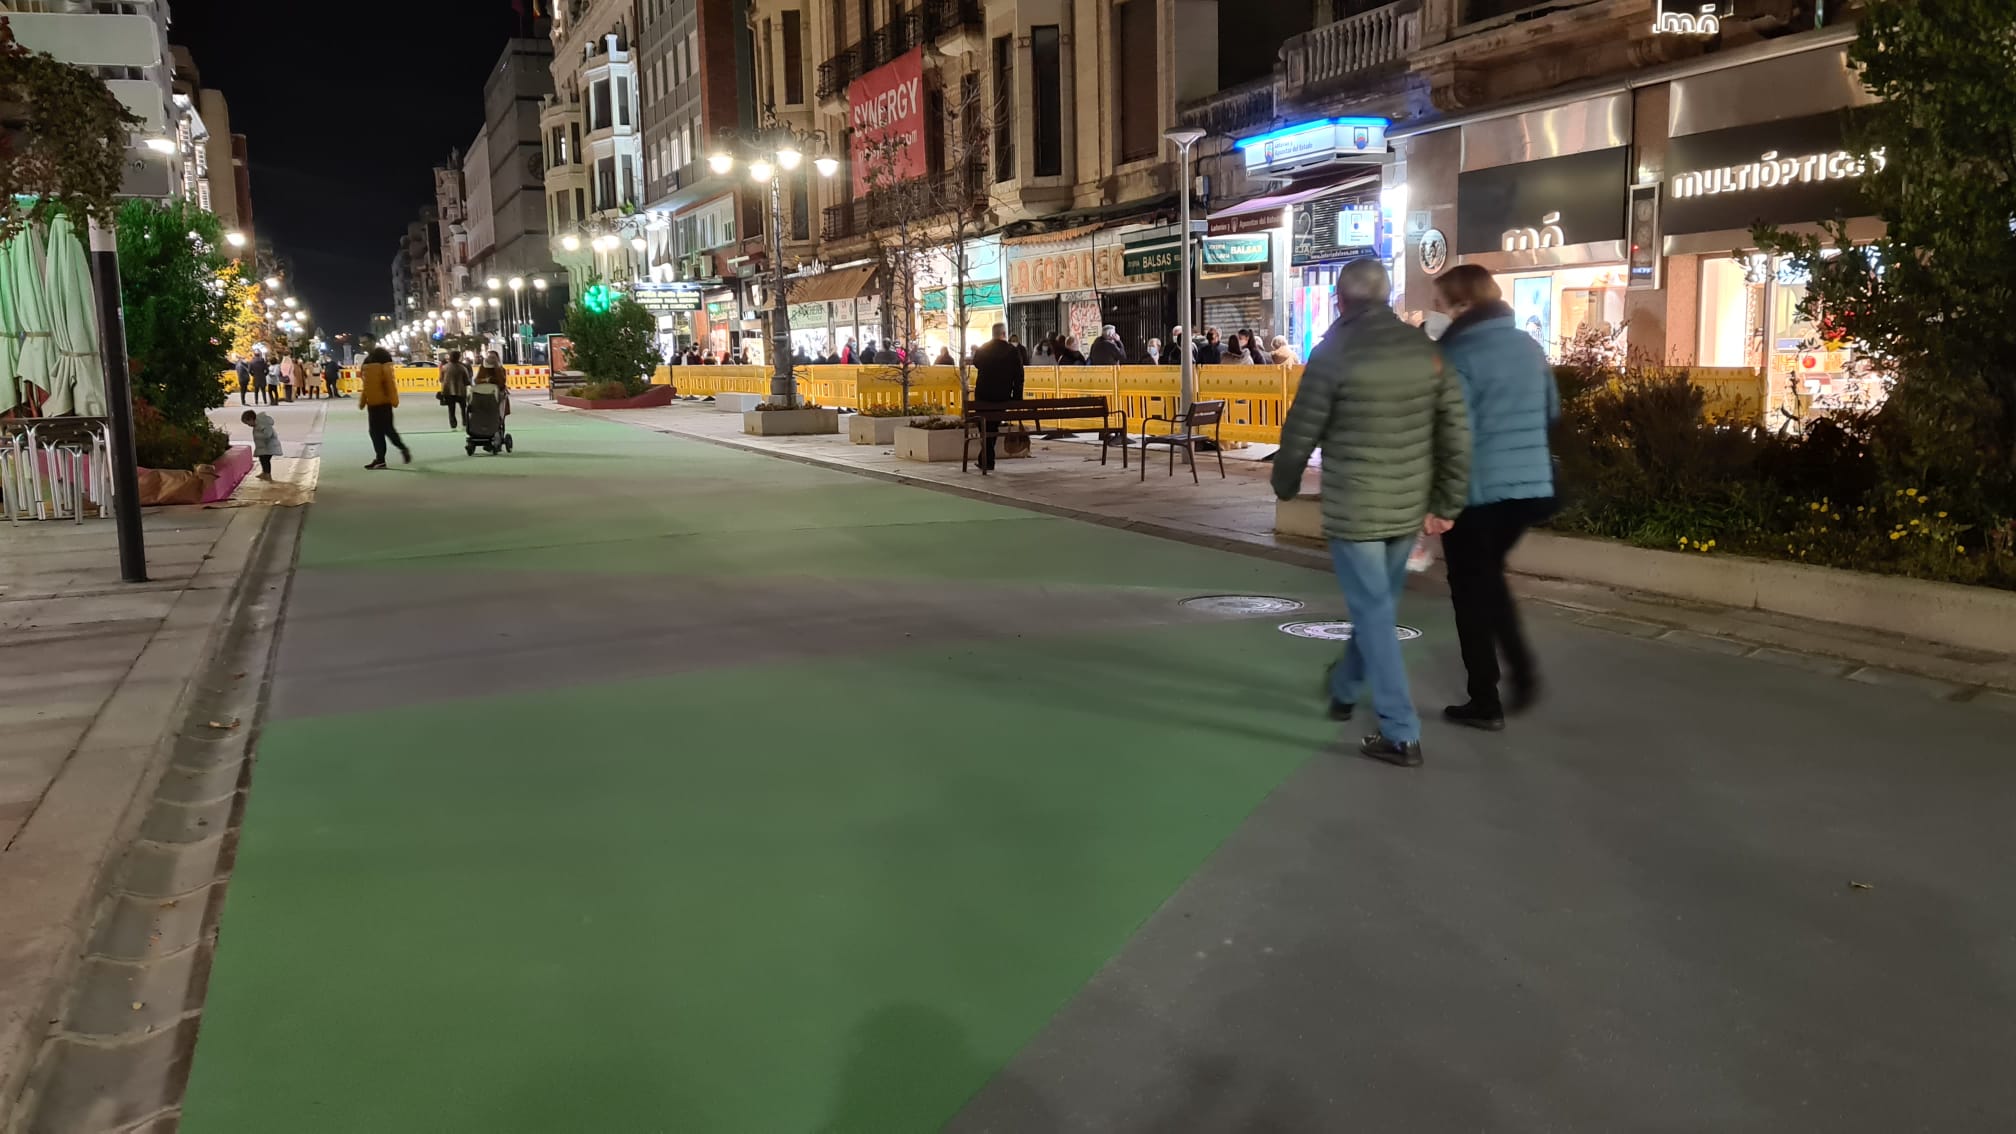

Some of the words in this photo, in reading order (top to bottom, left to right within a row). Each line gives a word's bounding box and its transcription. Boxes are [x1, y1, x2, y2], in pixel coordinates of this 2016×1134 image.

[854, 77, 918, 138] SYNERGY
[1299, 143, 1313, 151] Estado
[1230, 244, 1263, 255] BALSAS
[1142, 253, 1172, 269] BALSAS
